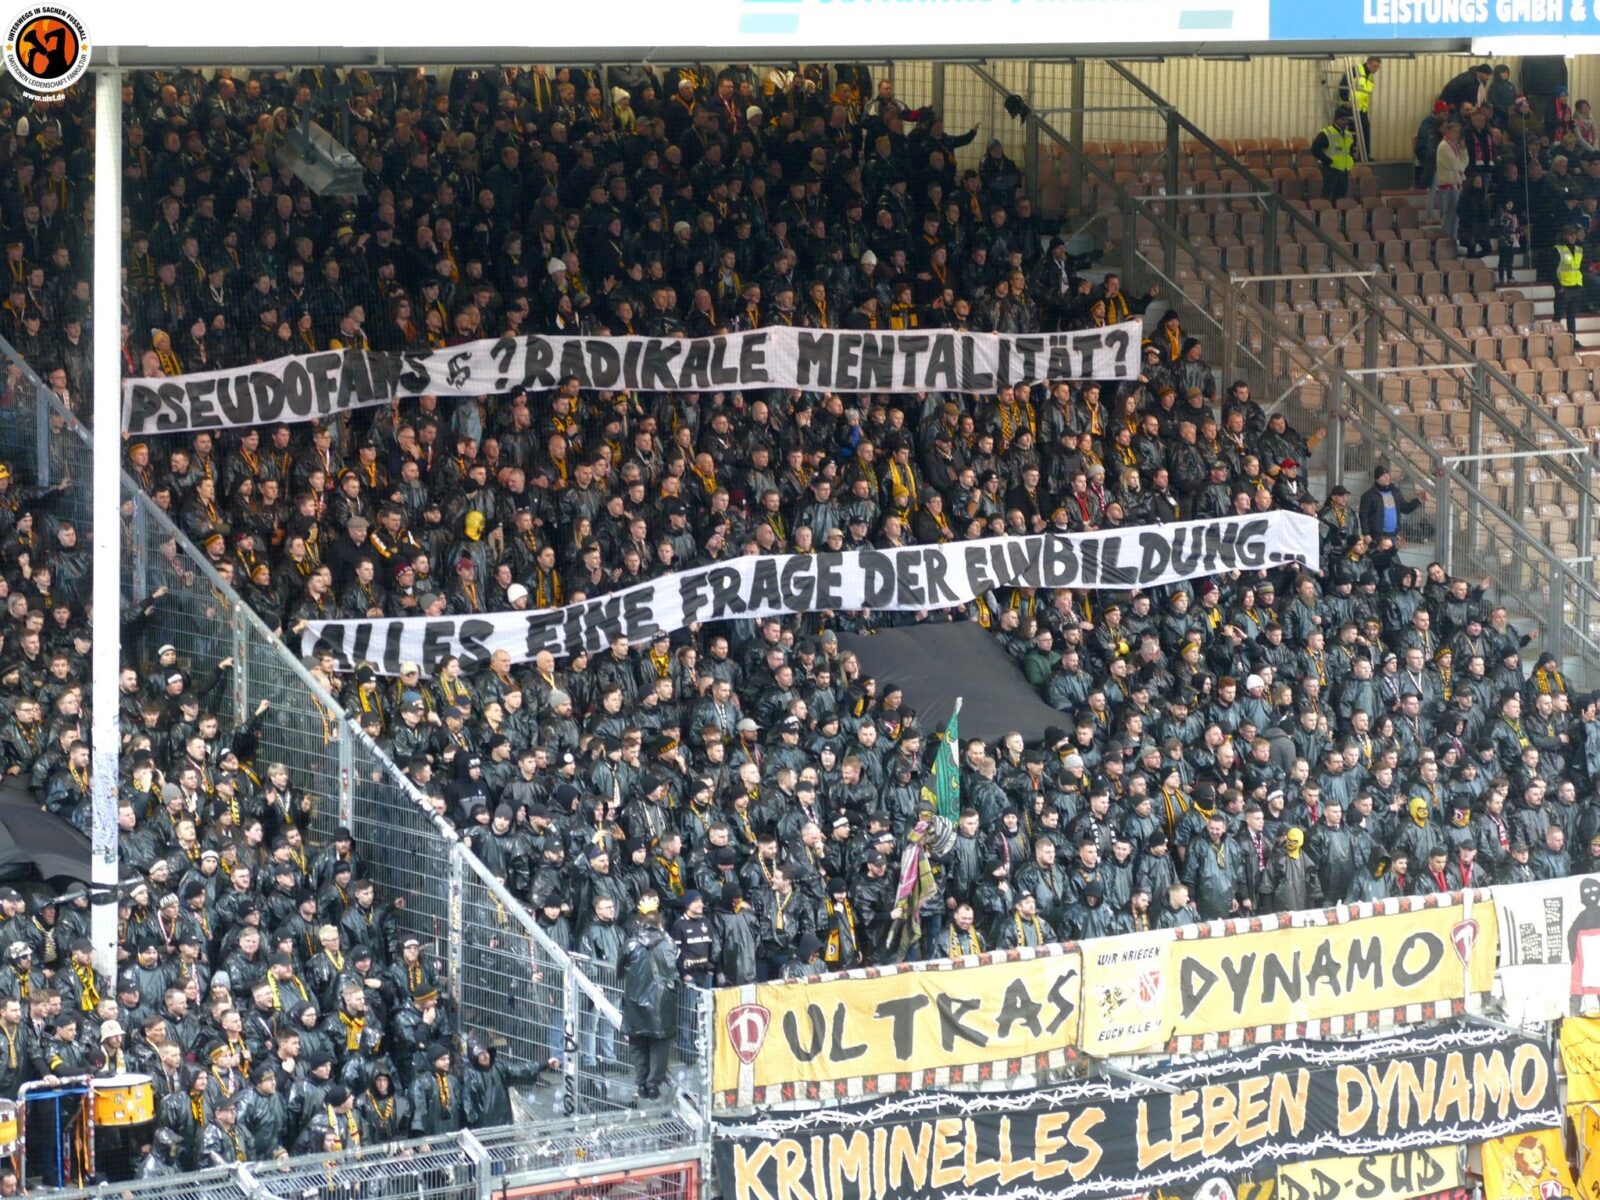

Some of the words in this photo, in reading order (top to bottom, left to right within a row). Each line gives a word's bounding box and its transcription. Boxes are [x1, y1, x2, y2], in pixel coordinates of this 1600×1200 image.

[1364, 0, 1488, 24] LEISTUNGS
[1496, 0, 1563, 23] GMBH
[1570, 0, 1587, 22] &
[129, 350, 434, 433] PSEUDOFANS
[796, 329, 1129, 390] MENTALITÄT?
[311, 619, 494, 678] ALLES
[526, 585, 662, 657] EINE
[679, 552, 844, 625] FRAGE
[859, 549, 960, 608] DER
[782, 969, 1078, 1062] ULTRAS
[1180, 931, 1445, 1020] DYNAMO
[1097, 953, 1118, 965] WIR
[1098, 1027, 1125, 1041] EUCH
[1128, 1021, 1151, 1036] ALLE
[733, 1106, 1107, 1200] KRIMINELLES
[1136, 1067, 1310, 1171] LEBEN
[1336, 1042, 1549, 1137] DYNAMO
